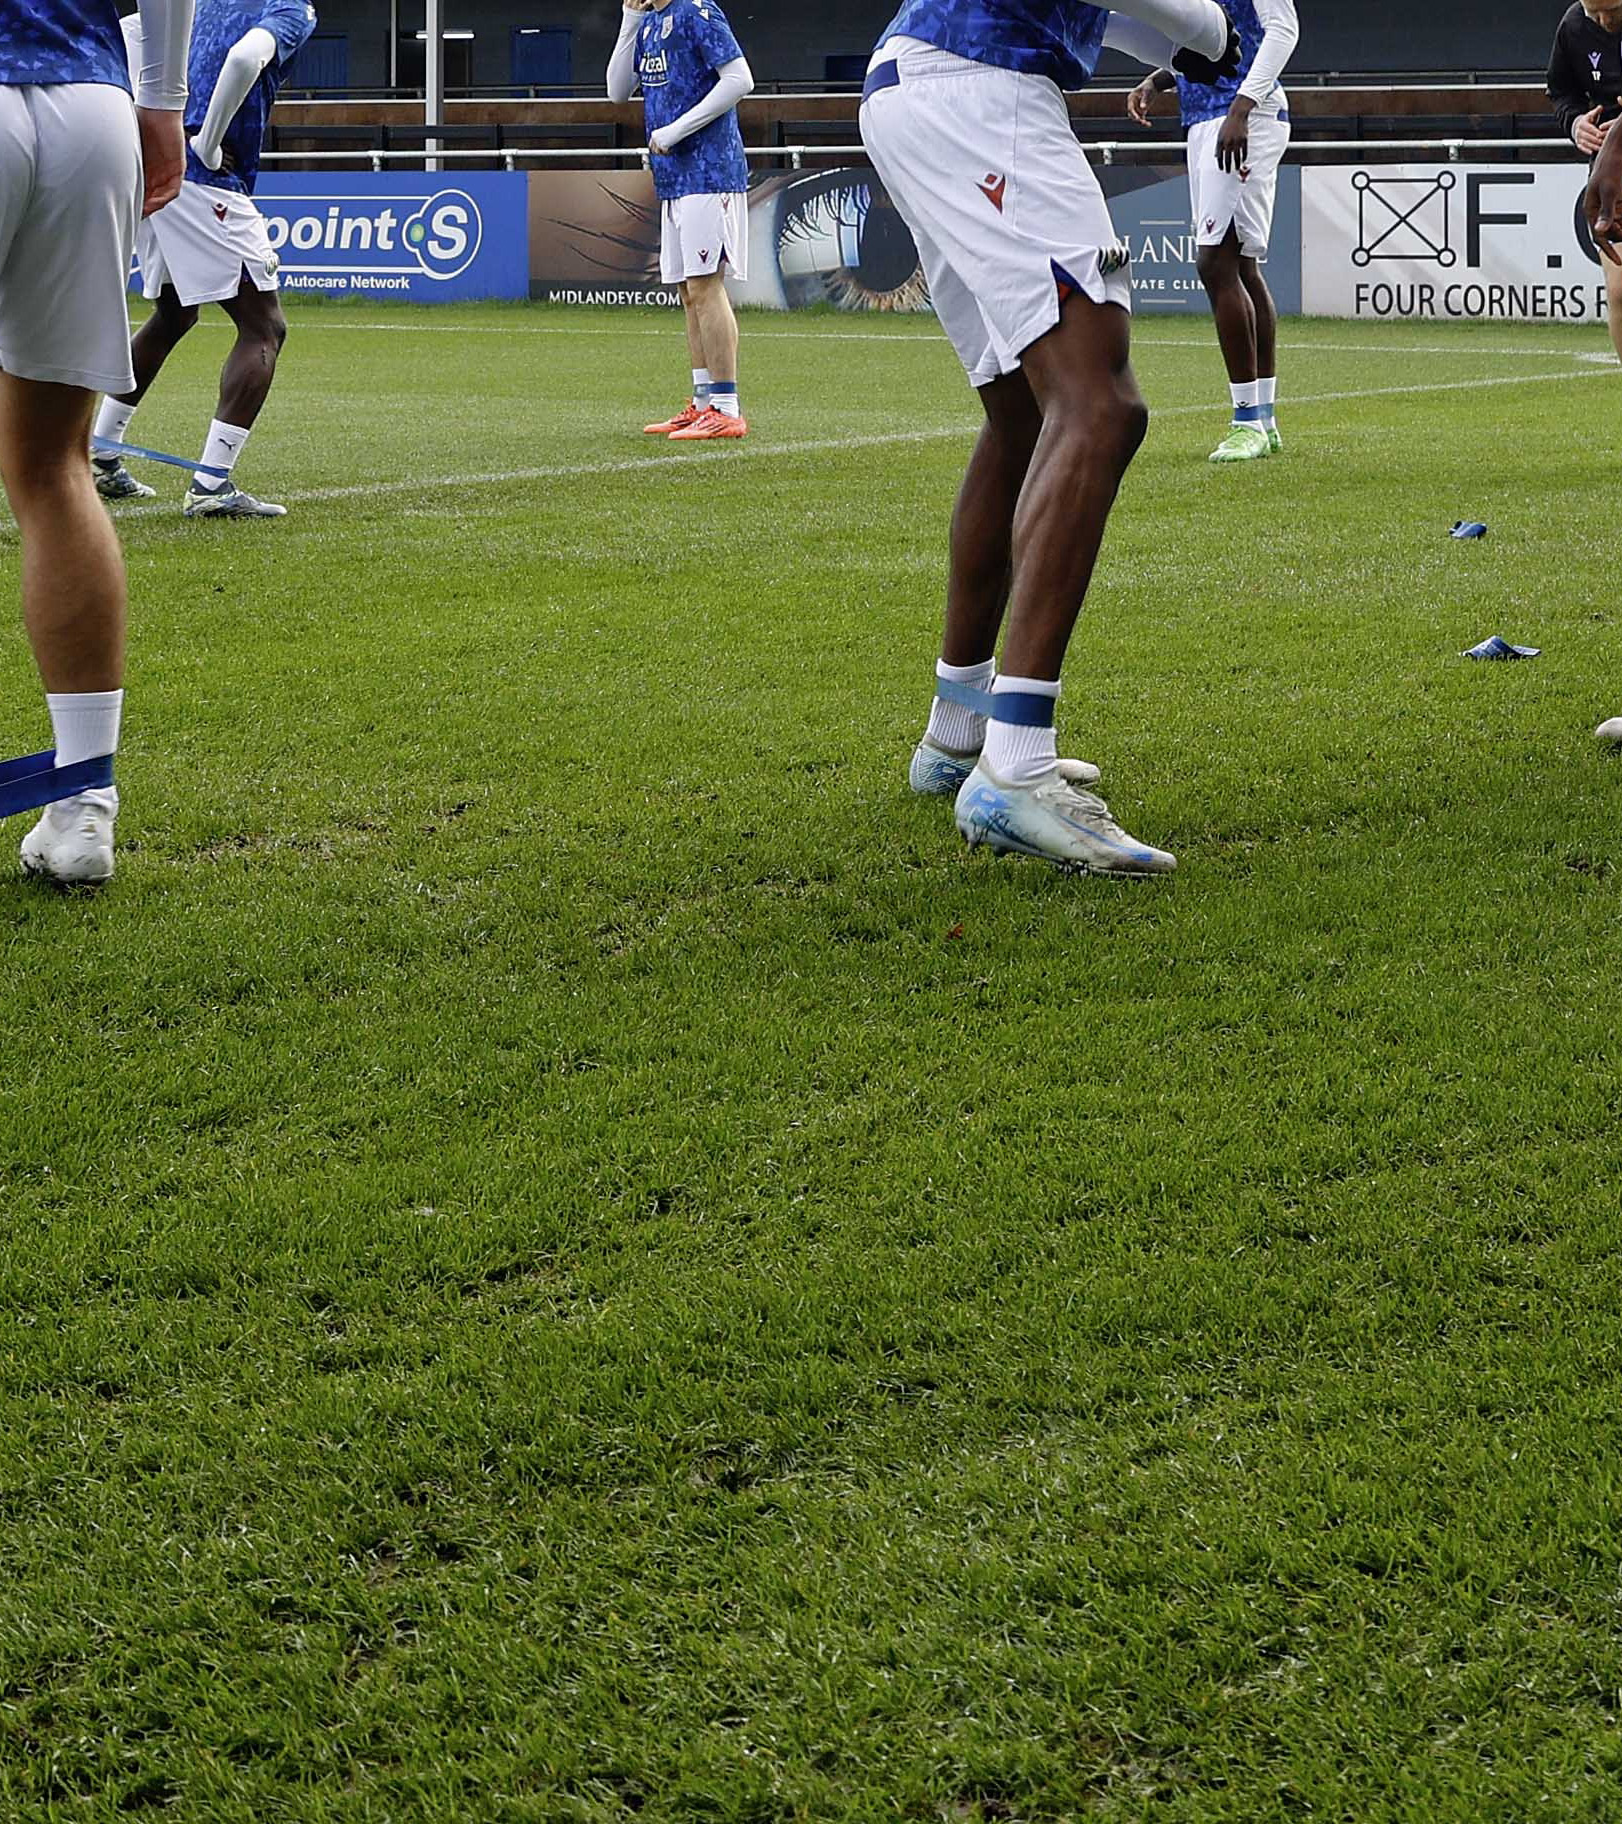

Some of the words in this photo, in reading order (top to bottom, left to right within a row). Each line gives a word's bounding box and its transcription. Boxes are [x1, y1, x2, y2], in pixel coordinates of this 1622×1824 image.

[263, 207, 397, 250] point
[426, 205, 469, 260] S
[284, 275, 347, 288] Autocare
[351, 275, 410, 289] Network
[549, 290, 680, 306] MIDLANDEYE.COM
[1356, 284, 1435, 315] FOUR
[1444, 284, 1585, 318] CORNERS
